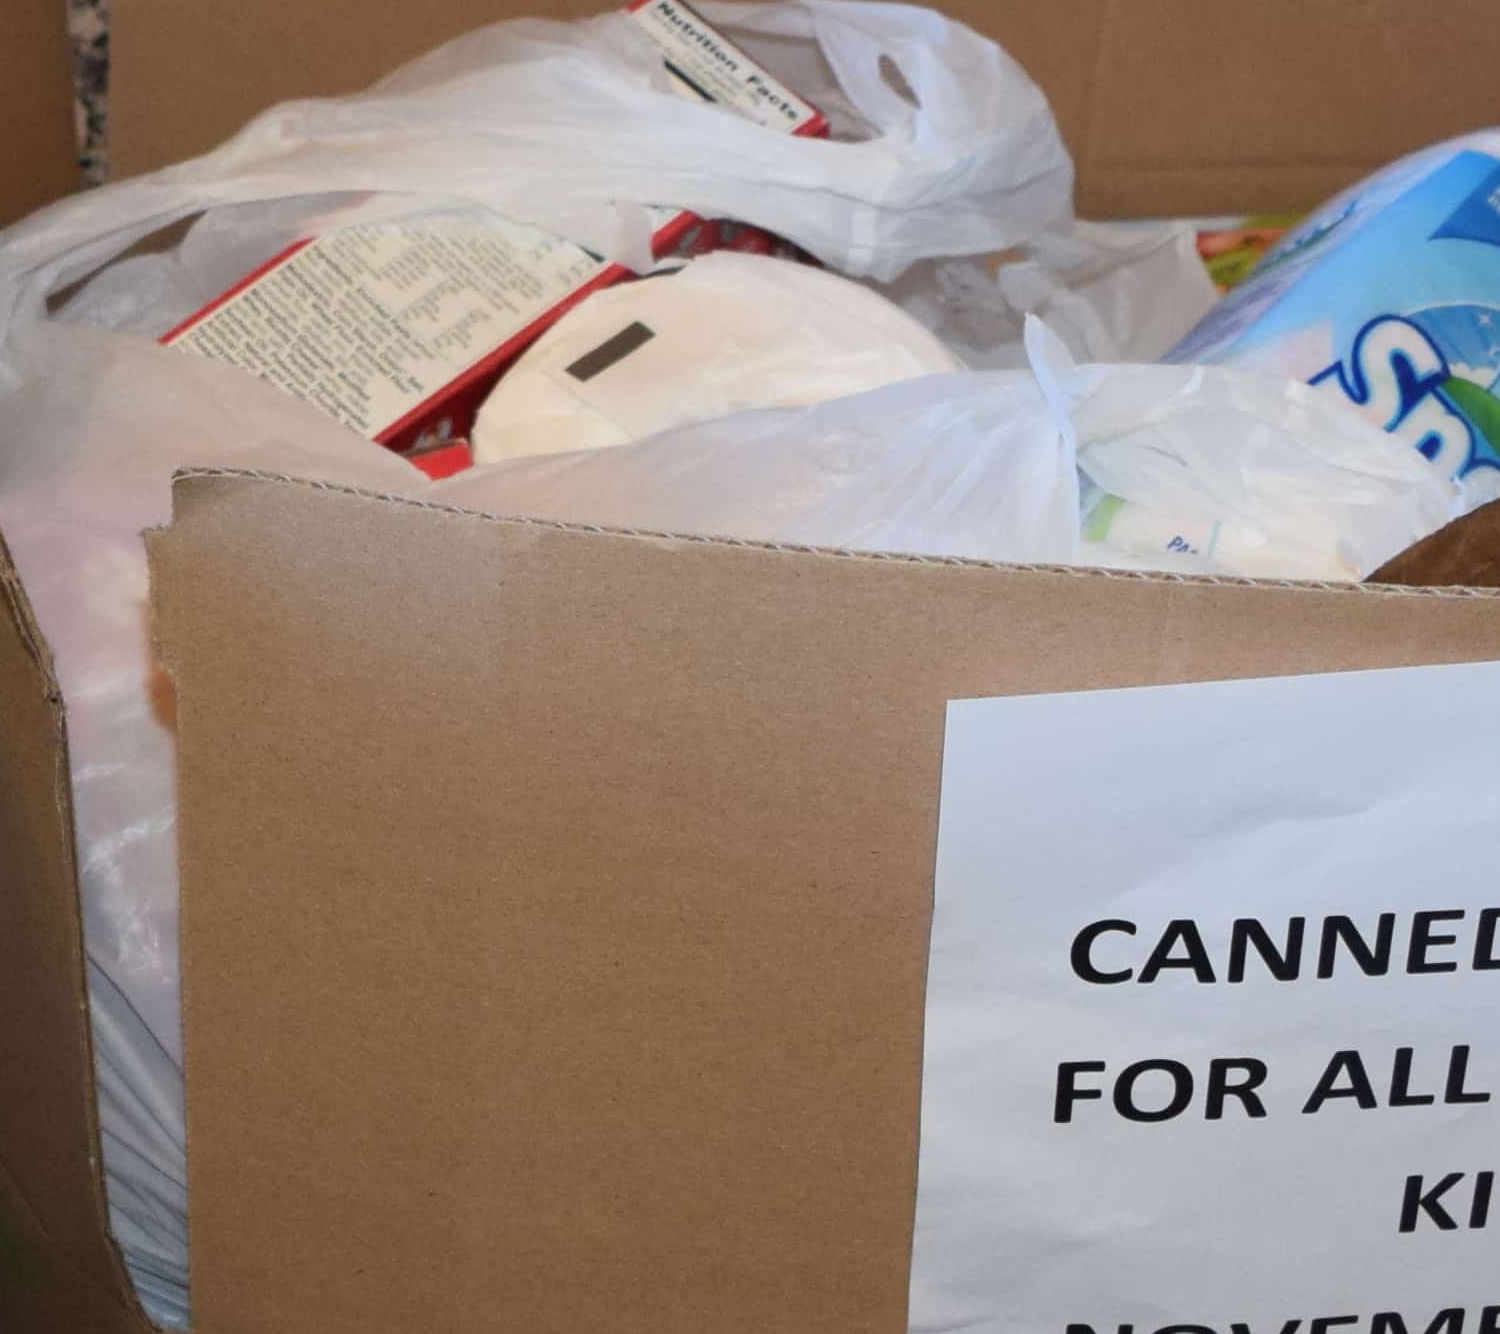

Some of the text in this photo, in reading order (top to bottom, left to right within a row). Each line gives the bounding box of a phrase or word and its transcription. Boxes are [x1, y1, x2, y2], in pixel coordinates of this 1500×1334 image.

[745, 72, 802, 122] Facts
[1055, 1058, 1266, 1123] FOR
[1303, 1046, 1490, 1113] ALL
